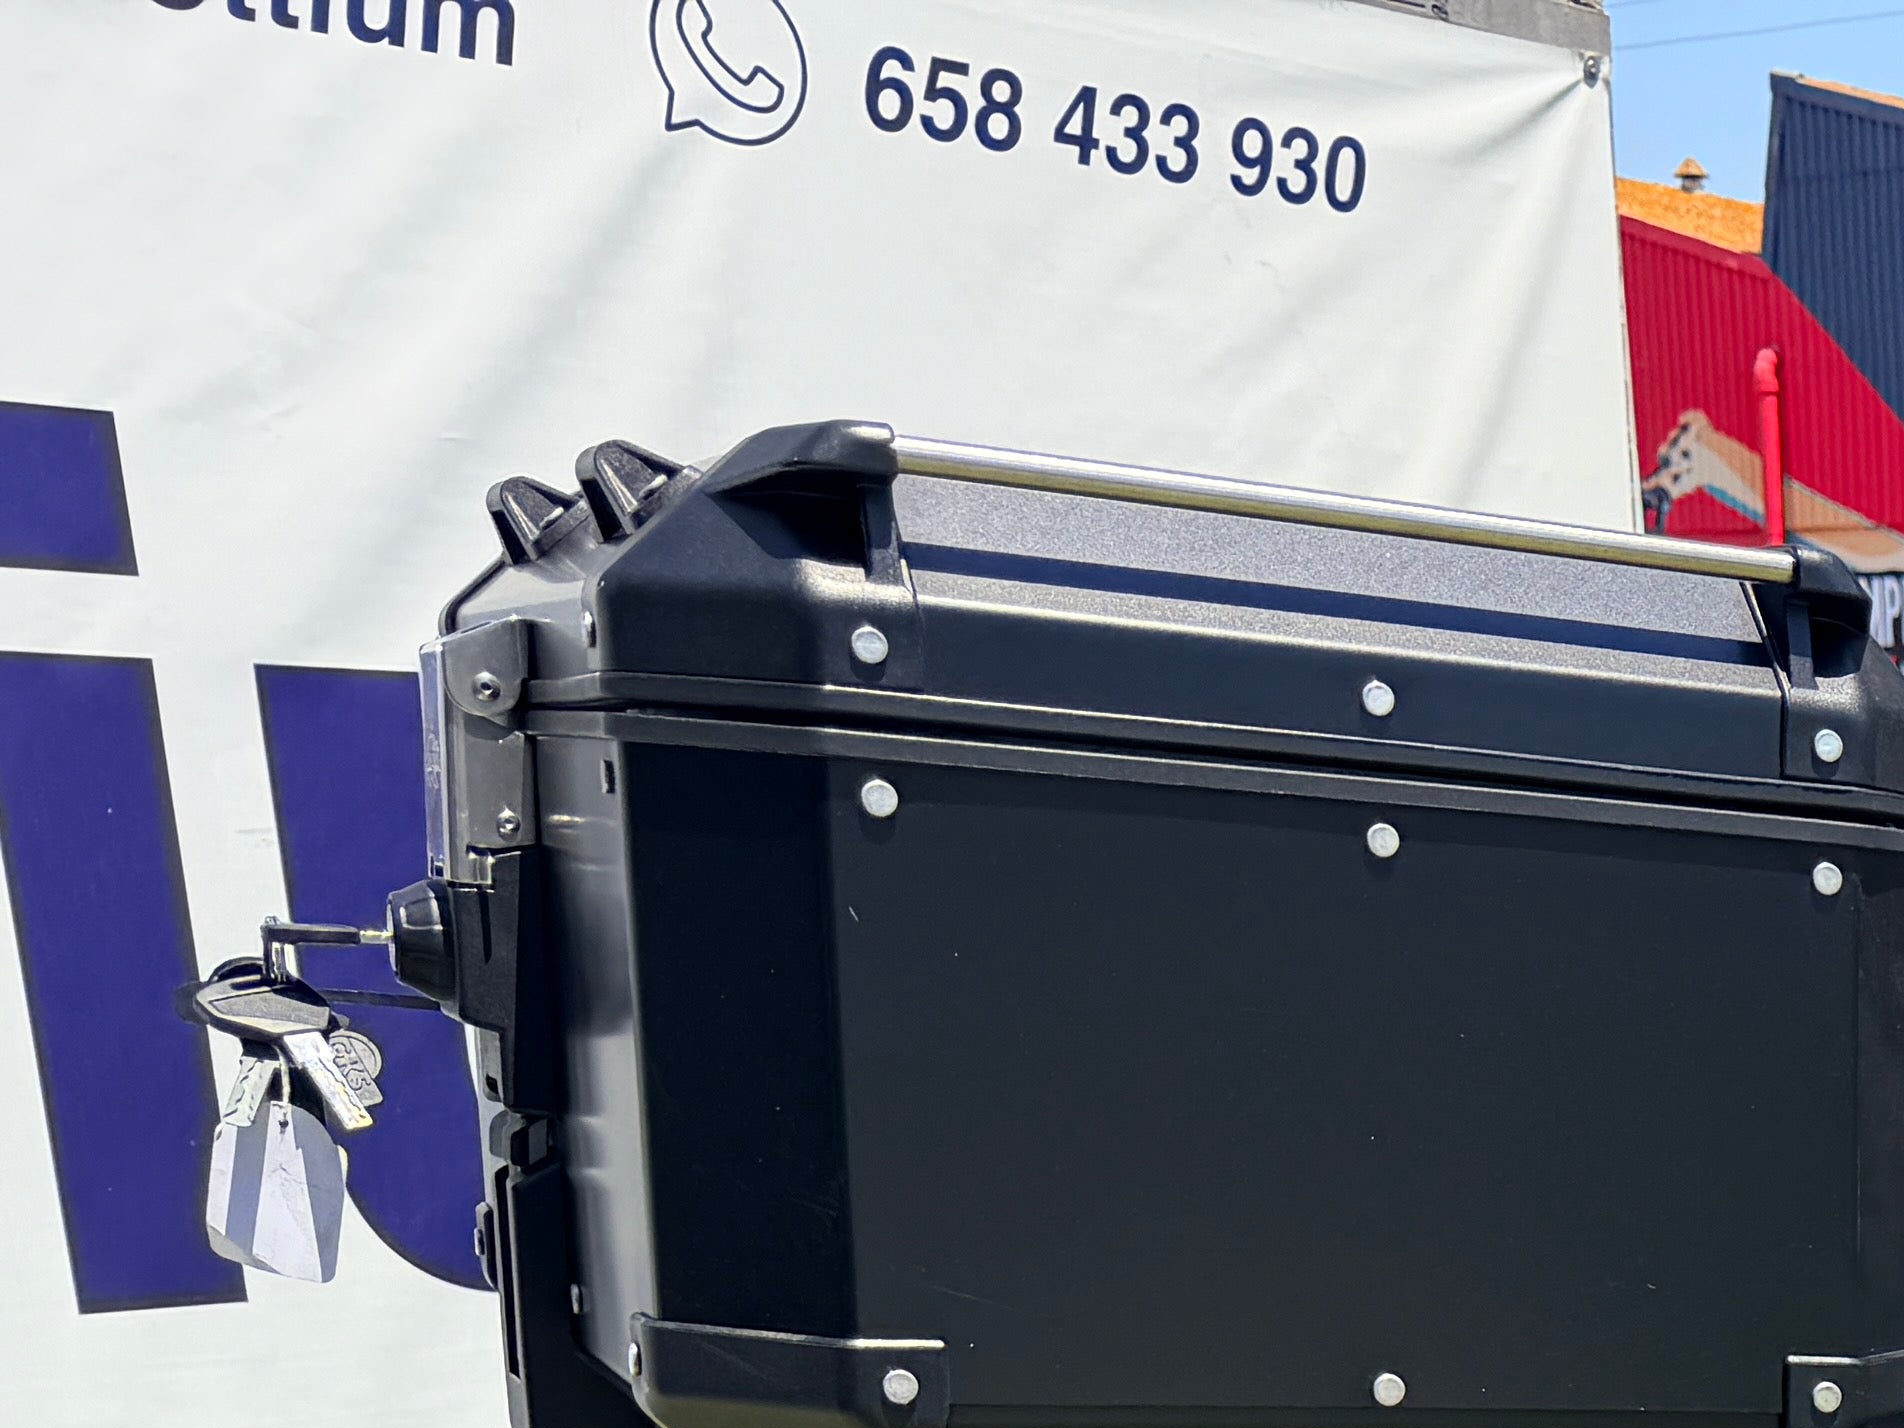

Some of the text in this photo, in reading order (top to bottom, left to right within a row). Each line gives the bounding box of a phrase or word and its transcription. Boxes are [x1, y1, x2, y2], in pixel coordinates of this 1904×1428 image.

[865, 45, 1367, 213] 658 433 930
